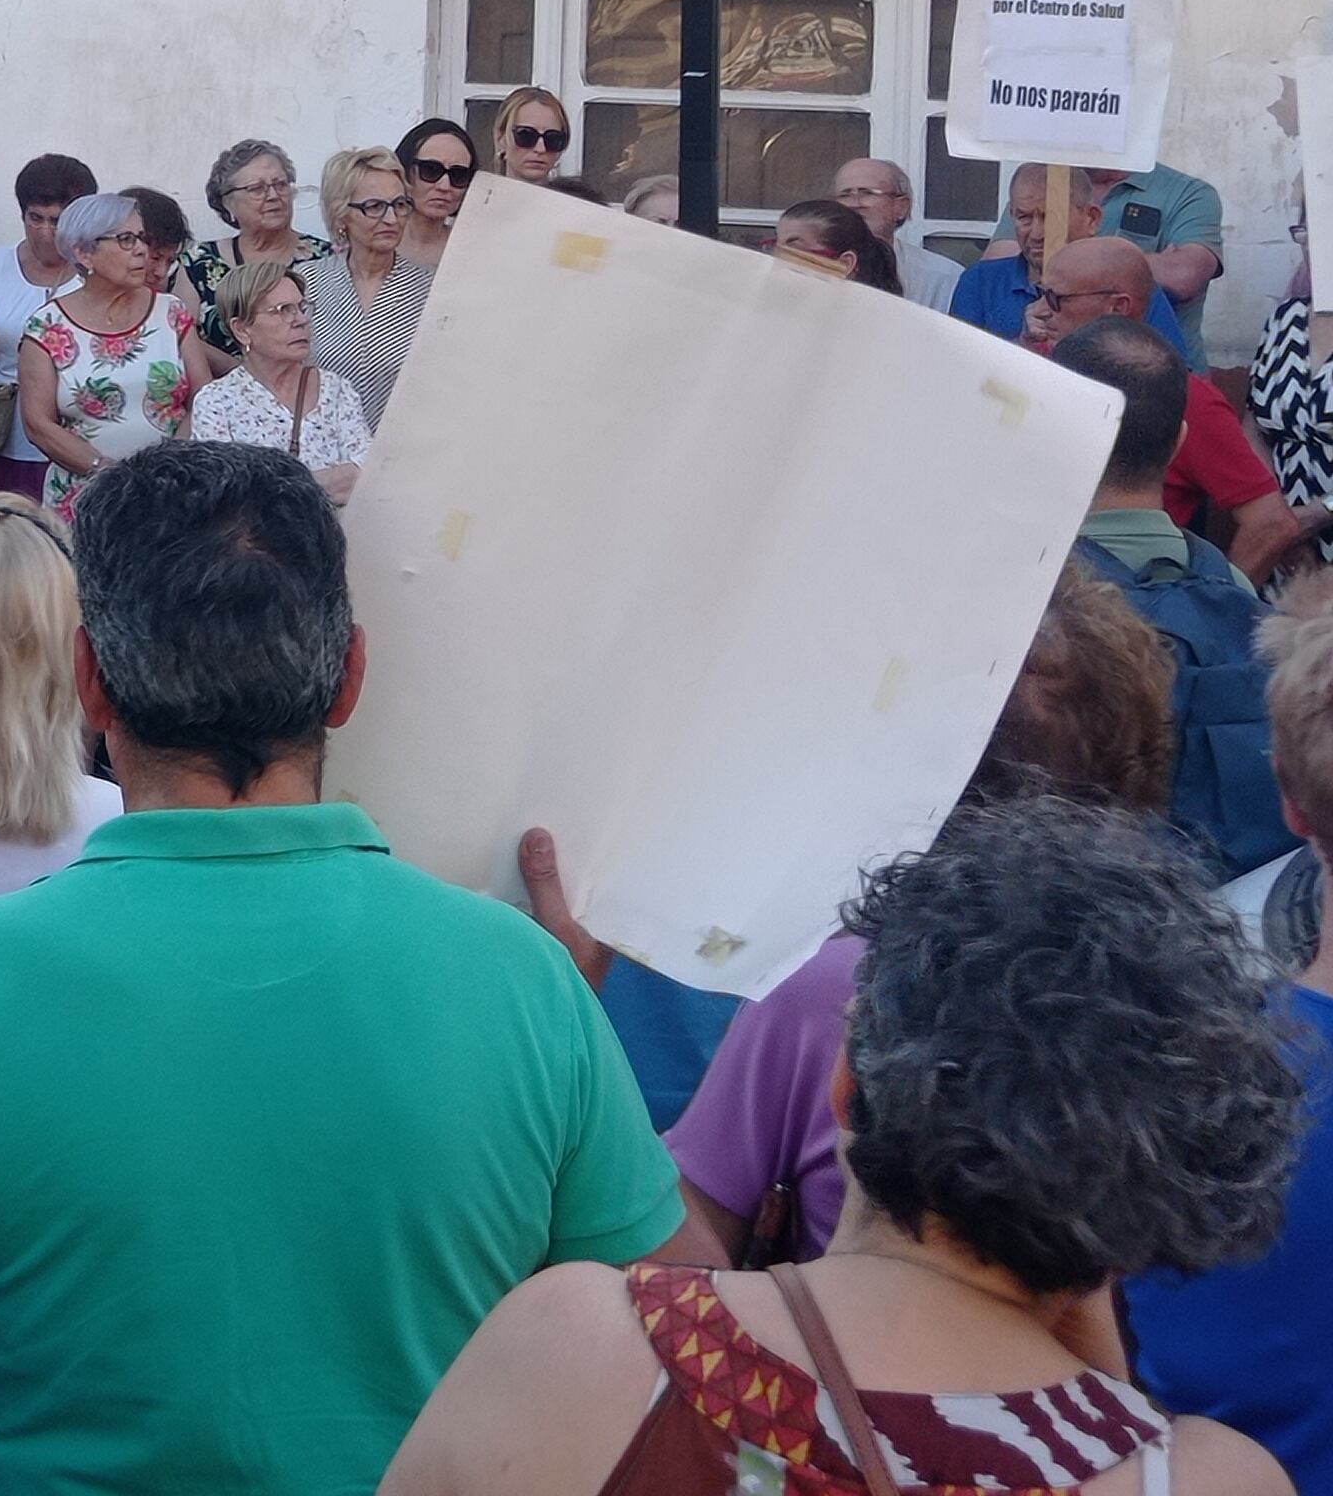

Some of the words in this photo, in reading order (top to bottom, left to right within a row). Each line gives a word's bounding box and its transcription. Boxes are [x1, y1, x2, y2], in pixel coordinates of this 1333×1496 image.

[992, 0, 1014, 15] por
[1030, 0, 1070, 16] Centro
[1072, 1, 1088, 17] de
[1090, 2, 1125, 19] Salud
[990, 79, 1012, 105] No
[1016, 85, 1048, 108] nos
[1050, 87, 1121, 115] pararán
